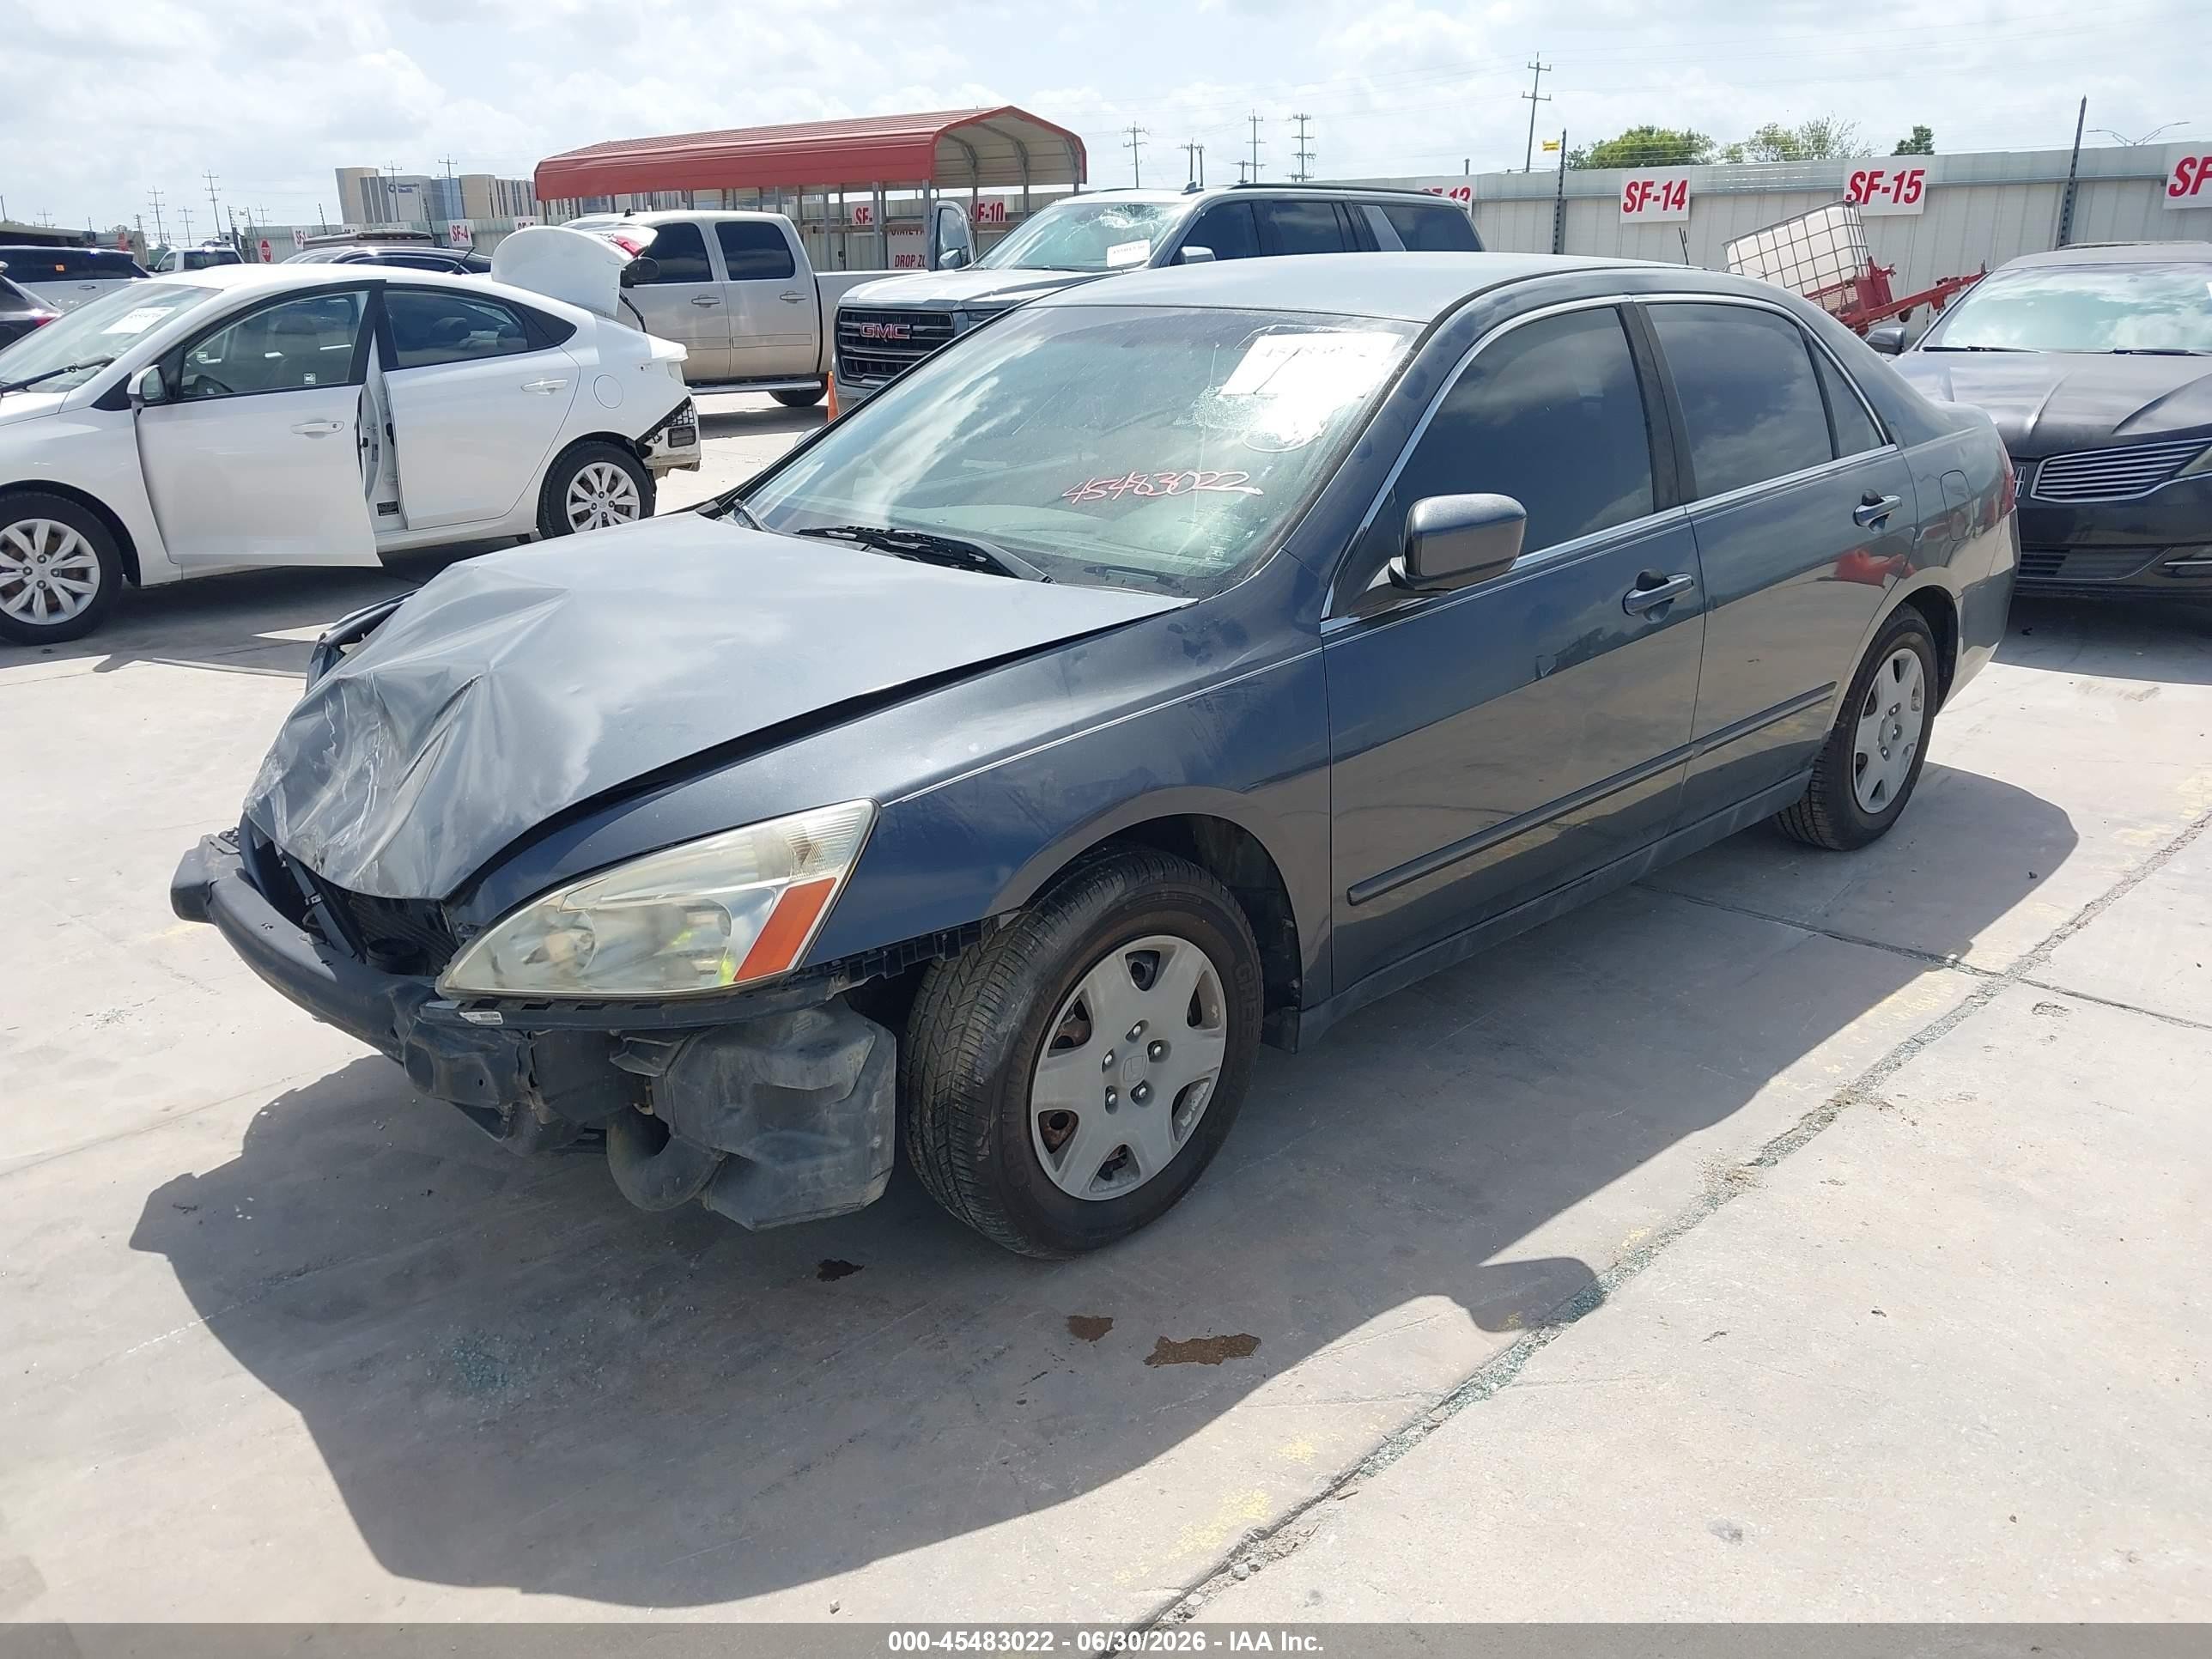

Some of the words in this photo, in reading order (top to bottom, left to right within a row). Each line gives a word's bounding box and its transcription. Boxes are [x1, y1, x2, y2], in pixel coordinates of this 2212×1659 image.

[1845, 169, 1925, 205] SF-15
[1622, 179, 1688, 213] SF-14
[855, 207, 873, 224] SF-
[452, 225, 469, 242] SF-4
[895, 254, 915, 268] DROP
[860, 323, 910, 339] GMC
[1061, 471, 1264, 505] 45483022
